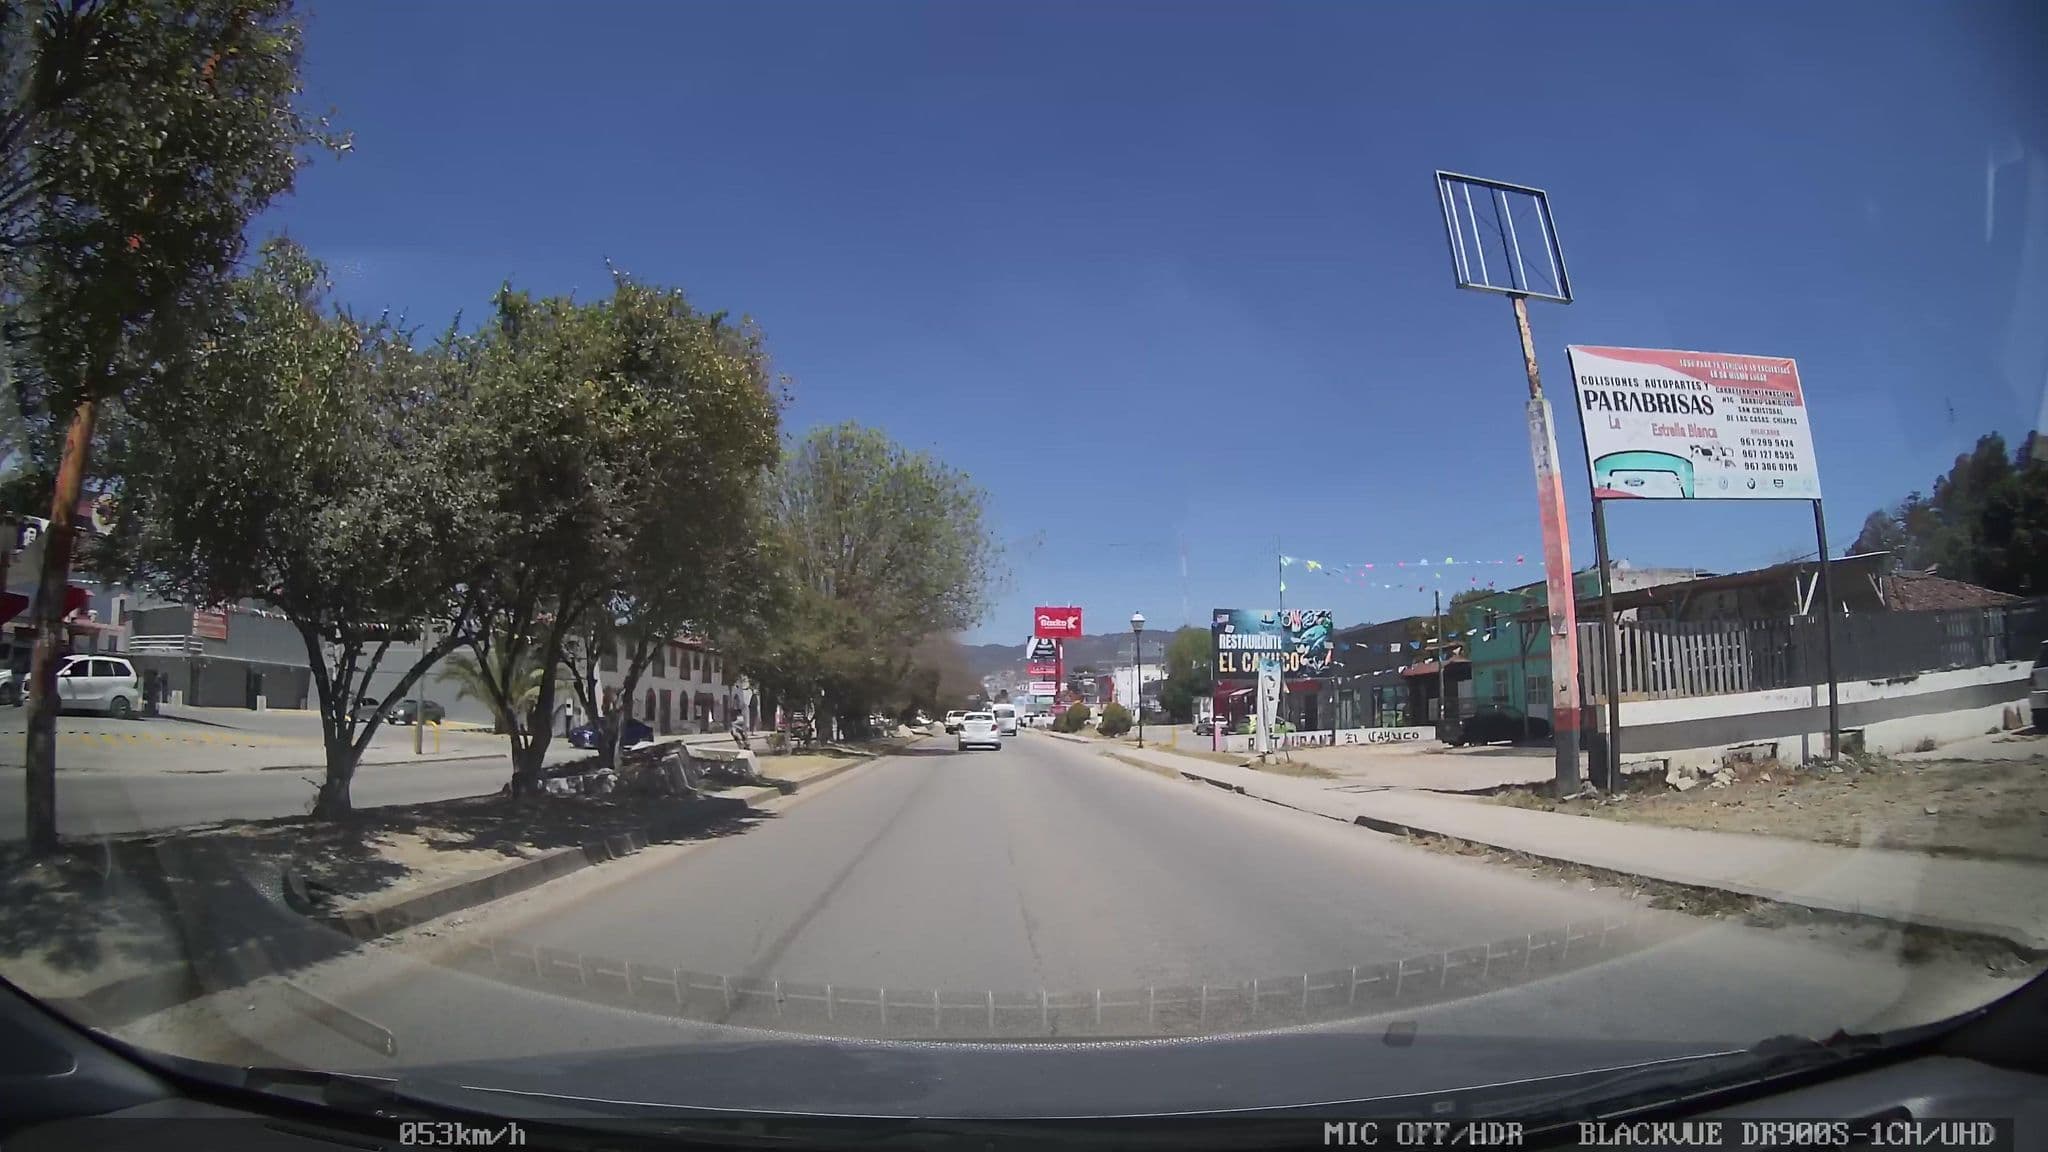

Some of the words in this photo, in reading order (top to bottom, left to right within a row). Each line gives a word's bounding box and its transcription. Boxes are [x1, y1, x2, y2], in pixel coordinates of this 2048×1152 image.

[1581, 375, 1640, 387] COLISIONES
[1645, 379, 1702, 391] AUTOPARTES
[1703, 382, 1710, 391] Y
[1715, 387, 1750, 395] CARRETERA
[1584, 389, 1715, 416] PARABRISAS
[1738, 406, 1750, 414] SAN
[1752, 407, 1783, 416] CRISTOBAL
[1608, 414, 1622, 430] La
[1736, 415, 1748, 423] LAS
[1773, 418, 1798, 426] CHIAPAS
[1652, 422, 1686, 438] Estrella
[1688, 423, 1718, 439] Blanca
[1218, 652, 1236, 673] EL
